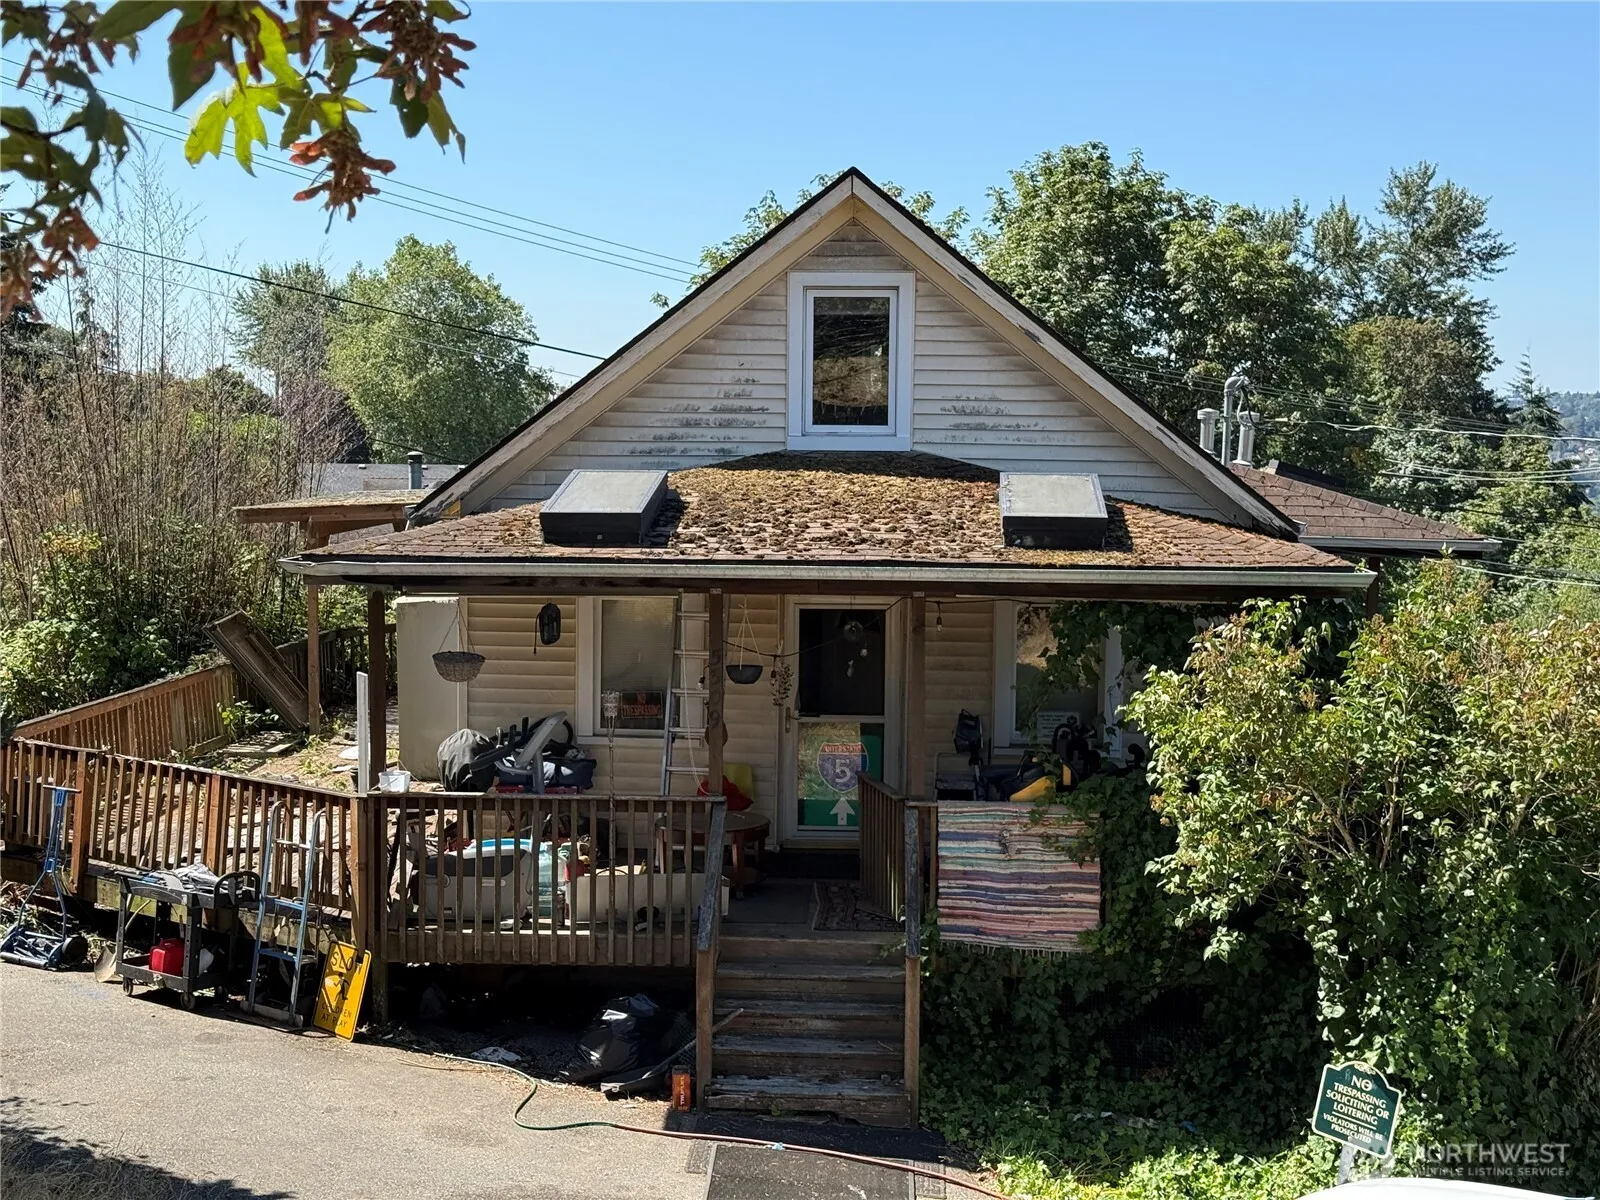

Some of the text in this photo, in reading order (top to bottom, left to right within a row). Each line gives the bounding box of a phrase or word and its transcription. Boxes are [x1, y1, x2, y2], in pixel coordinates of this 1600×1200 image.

[637, 693, 646, 704] NO
[623, 704, 663, 716] TRESPASSING
[835, 759, 851, 783] 5
[331, 951, 358, 973] SLO
[321, 1013, 331, 1022] AT
[1351, 1075, 1373, 1091] NO
[1326, 1089, 1390, 1119] SOLICITING OR
[1334, 1082, 1387, 1108] TRESPASSING
[1333, 1102, 1378, 1125] LOITERING
[1323, 1113, 1384, 1141] VIOLATORS WILL BE
[1331, 1123, 1372, 1143] PROSECUTED
